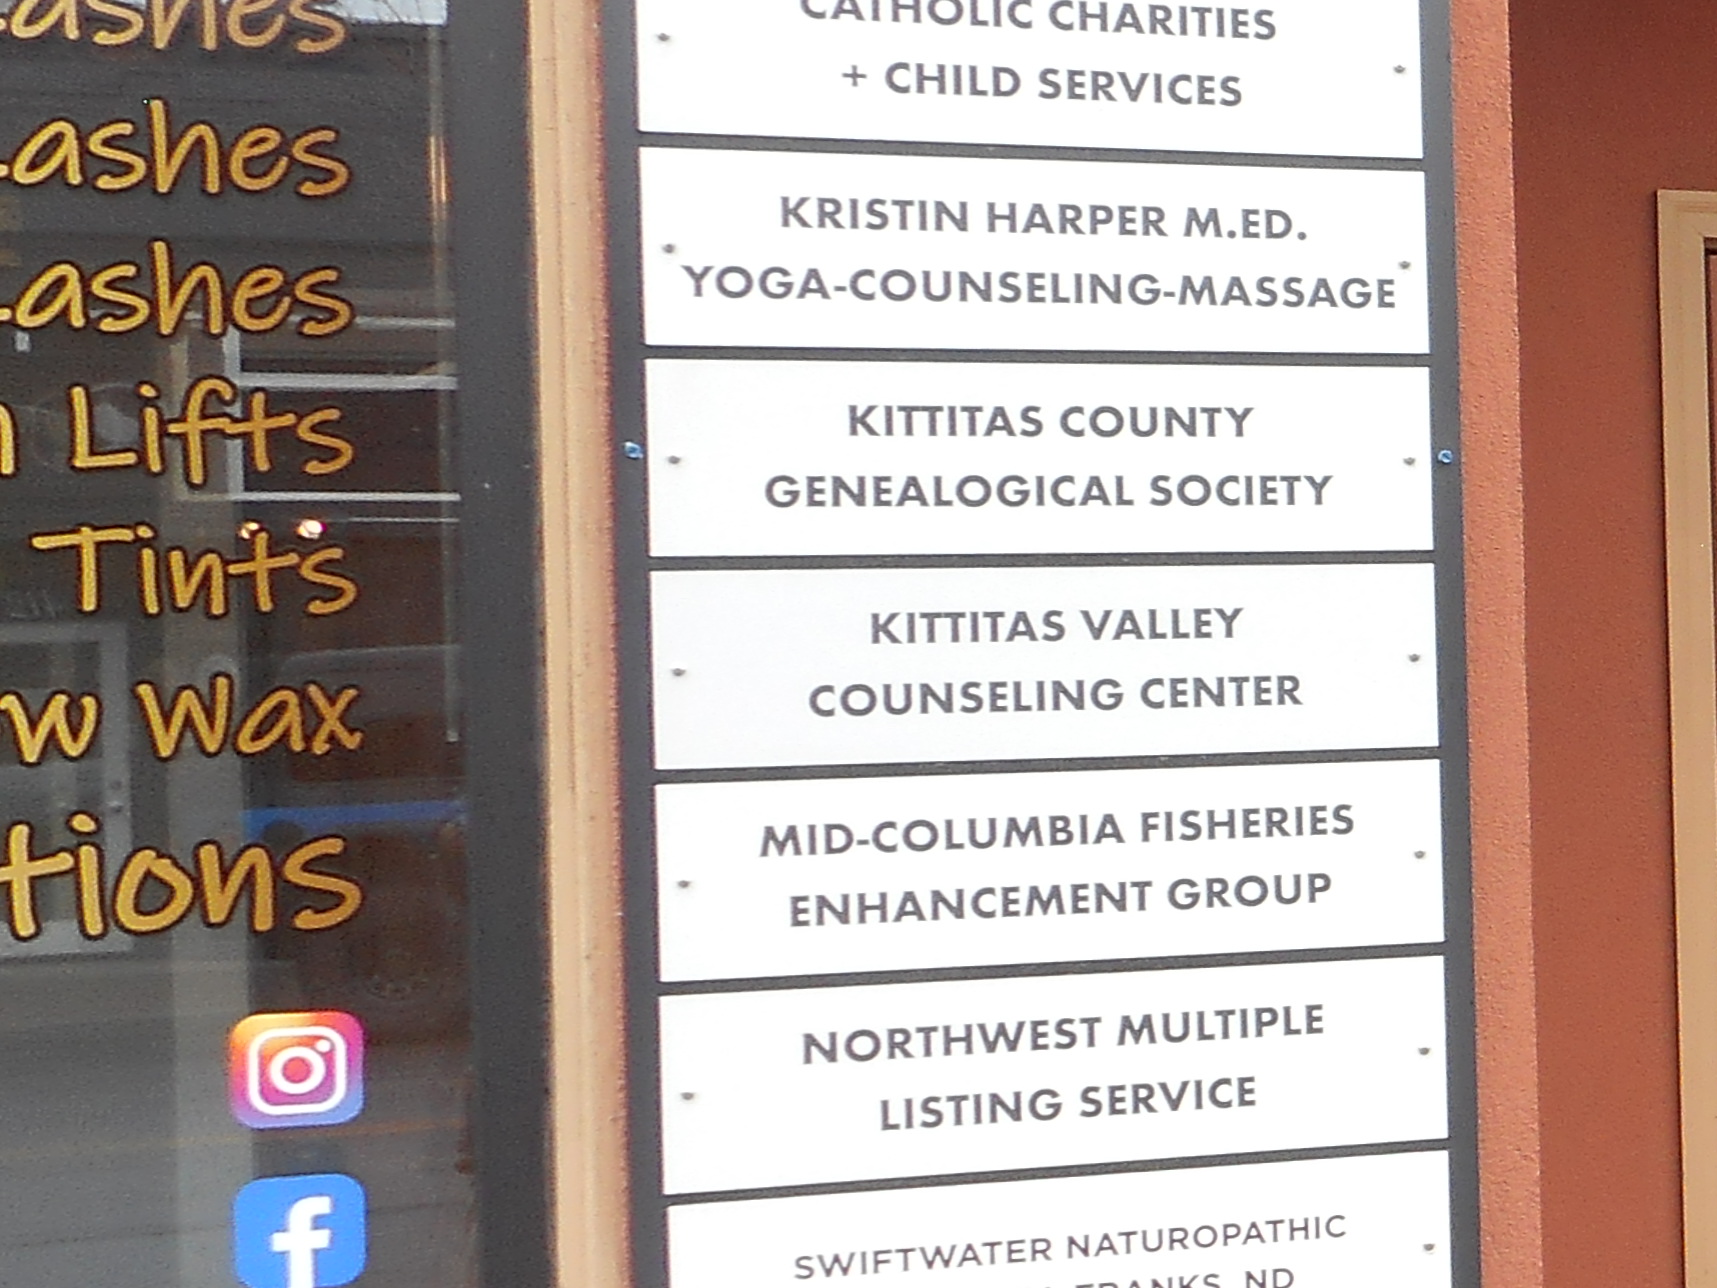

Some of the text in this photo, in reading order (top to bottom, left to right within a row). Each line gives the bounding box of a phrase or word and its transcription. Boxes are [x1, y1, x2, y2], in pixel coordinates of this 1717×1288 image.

[1049, 0, 1276, 40] CHARITIES
[842, 62, 1242, 107] + CHILD SERVICES
[0, 96, 351, 197] ashes
[781, 196, 1307, 241] KRISTIN HARPER M.ED.
[0, 238, 353, 338] ashes
[682, 265, 1395, 309] YOGA-COUNSELING-MASSAGE
[69, 375, 355, 488] Lifts
[849, 405, 1254, 438] KITTITAS COUNTY
[765, 474, 1333, 508] GENEALOGICAL SOCIETY
[29, 522, 358, 617] Tints
[871, 607, 1243, 644] KITTITAS VALLEY
[133, 671, 365, 761] Wax
[809, 675, 1303, 718] COUNSELING CENTER
[760, 804, 1354, 857] MID-COLUMBIA FISHERIES
[0, 812, 364, 940] tions
[790, 873, 1331, 927] ENHANCEMENT GROUP
[803, 1004, 1324, 1065] NORTHWEST MULTIPLE
[881, 1076, 1256, 1131] LISTING SERVICE
[795, 1214, 1346, 1280] SWIFTWATER NATUROPATHIC
